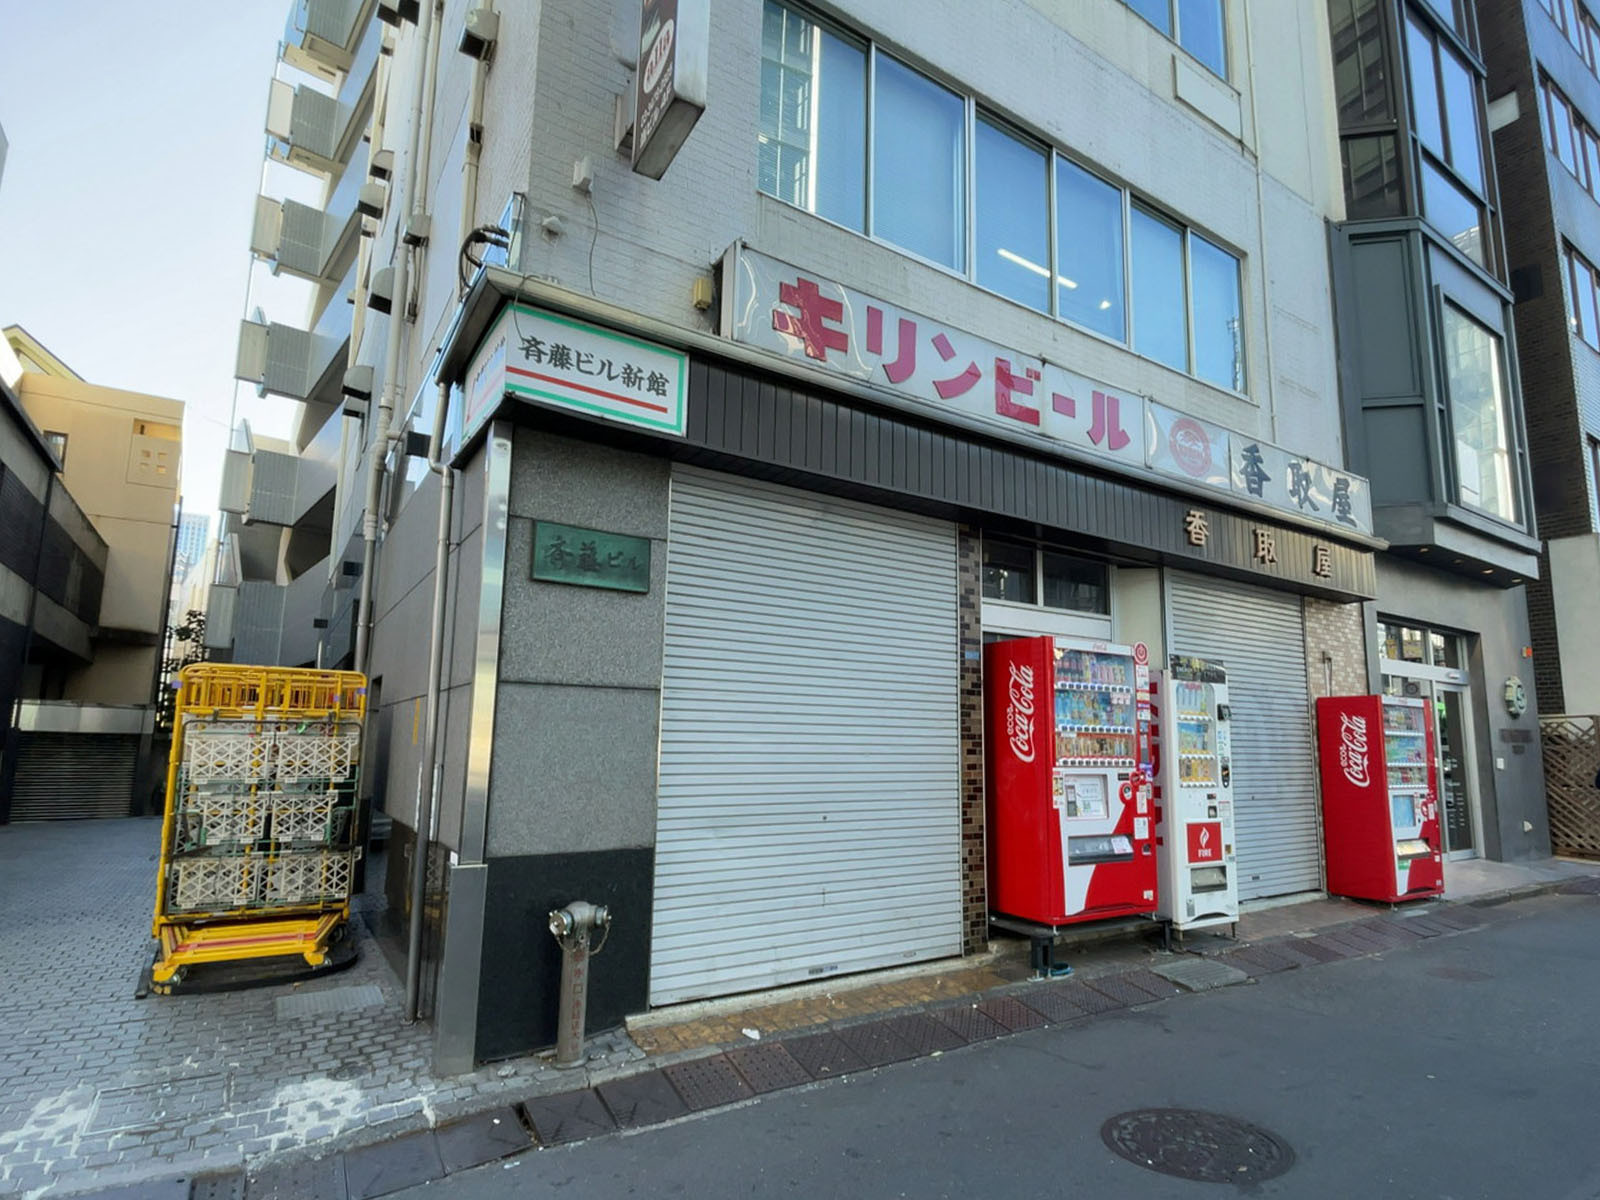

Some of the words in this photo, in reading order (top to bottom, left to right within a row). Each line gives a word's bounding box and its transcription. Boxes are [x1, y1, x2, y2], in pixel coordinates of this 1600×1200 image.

[518, 334, 670, 397] 斉藤ビル新館
[773, 276, 1131, 451] キリンビール
[1239, 443, 1358, 528] 香取屋
[1183, 509, 1334, 578] 香取屋
[1009, 660, 1035, 763] Coca-Cola
[1340, 711, 1370, 788] Coca-Cola
